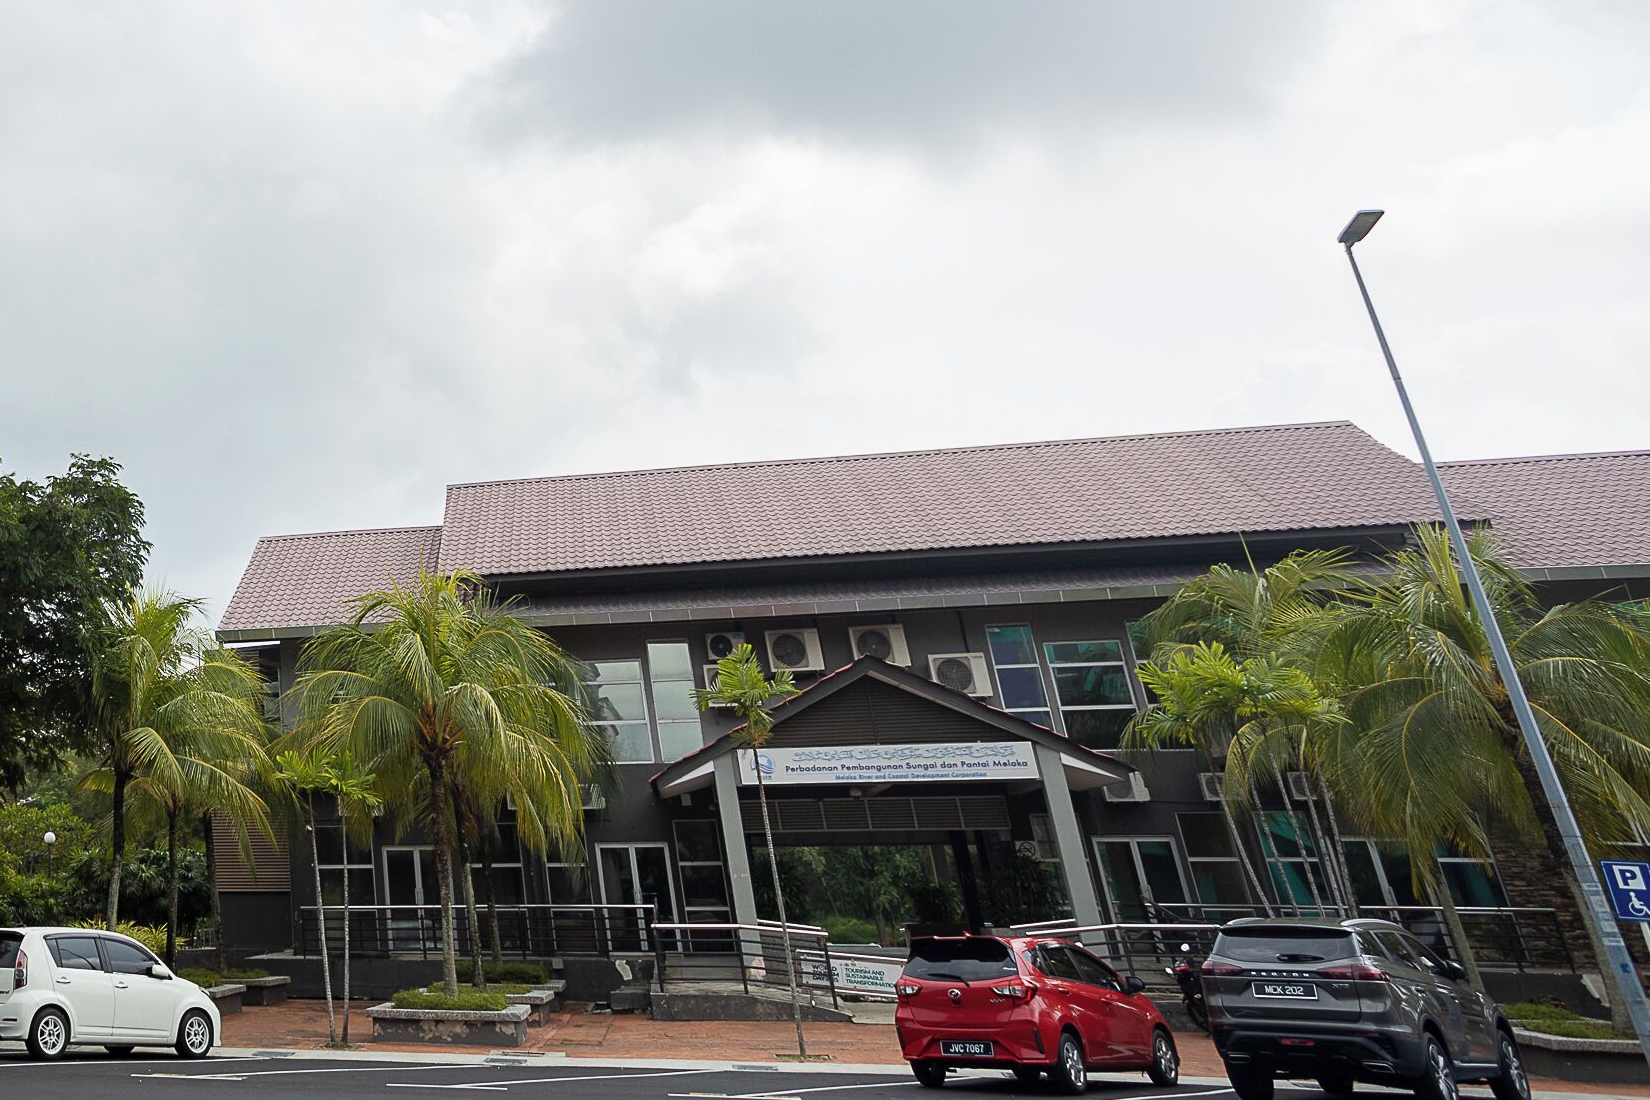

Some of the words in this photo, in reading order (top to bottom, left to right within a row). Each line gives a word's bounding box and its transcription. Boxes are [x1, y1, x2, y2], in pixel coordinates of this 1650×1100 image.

[785, 764, 838, 773] Perbadanan
[841, 762, 903, 773] Pembangunan
[906, 761, 938, 771] Sungai
[941, 760, 958, 769] dan
[961, 760, 989, 768] Pantai
[993, 758, 1028, 767] Melaka
[911, 771, 950, 780] Development
[952, 770, 987, 779] Corporation
[1618, 868, 1637, 886] P
[844, 967, 870, 975] TOURISM
[844, 972, 884, 981] SUSTAINABLE
[845, 978, 895, 988] TRANSFORMATIO
[1264, 985, 1284, 994] MCK
[1285, 986, 1305, 995] 202
[950, 1043, 964, 1053] JVC
[964, 1043, 984, 1053] 7067
